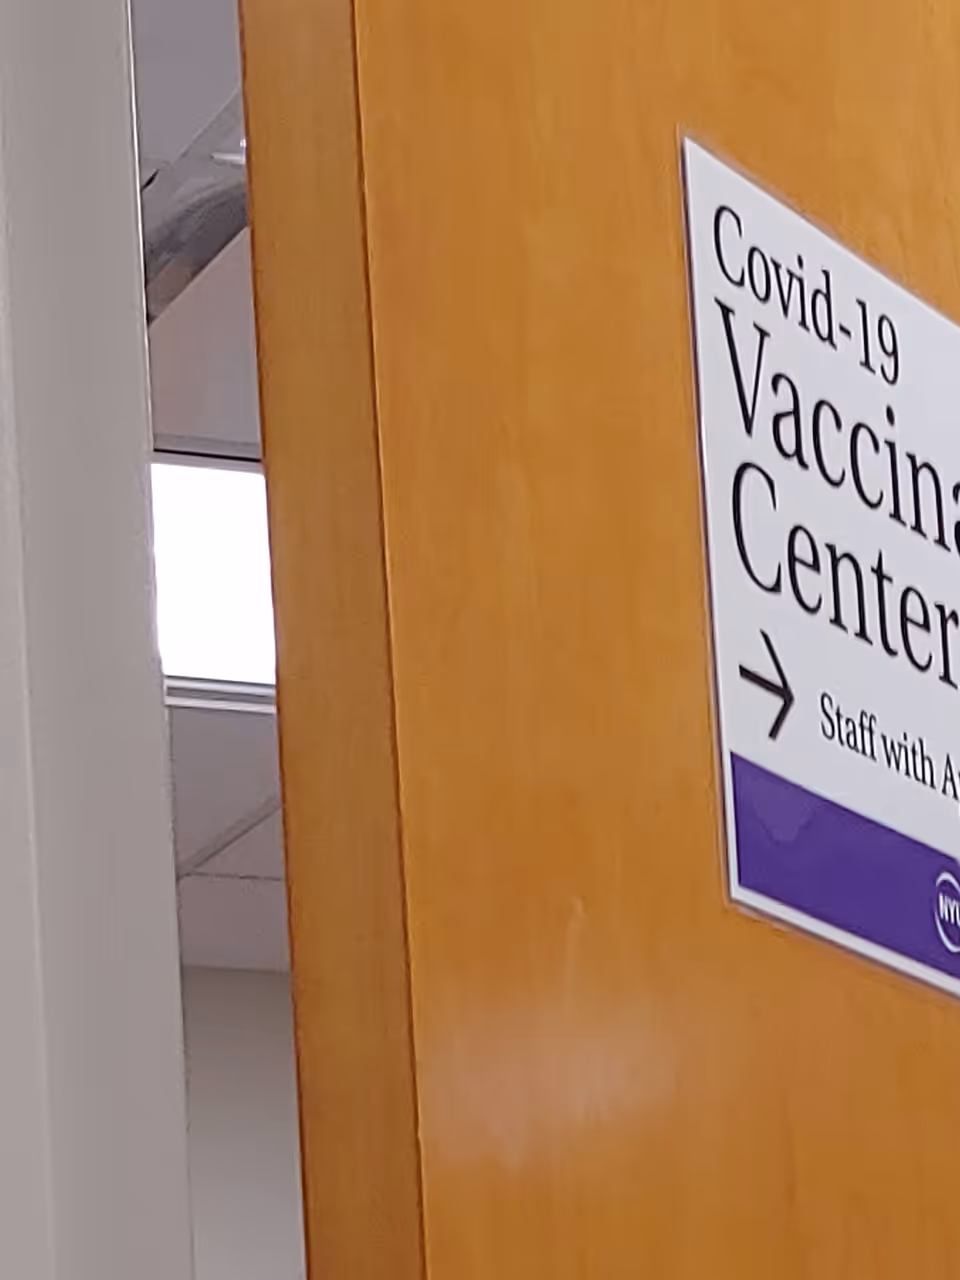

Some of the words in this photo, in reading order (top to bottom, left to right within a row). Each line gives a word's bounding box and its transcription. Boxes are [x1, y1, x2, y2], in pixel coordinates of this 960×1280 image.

[713, 205, 900, 385] Covid-19
[732, 462, 959, 689] Center
[820, 693, 877, 762] Staff
[881, 731, 936, 789] with
